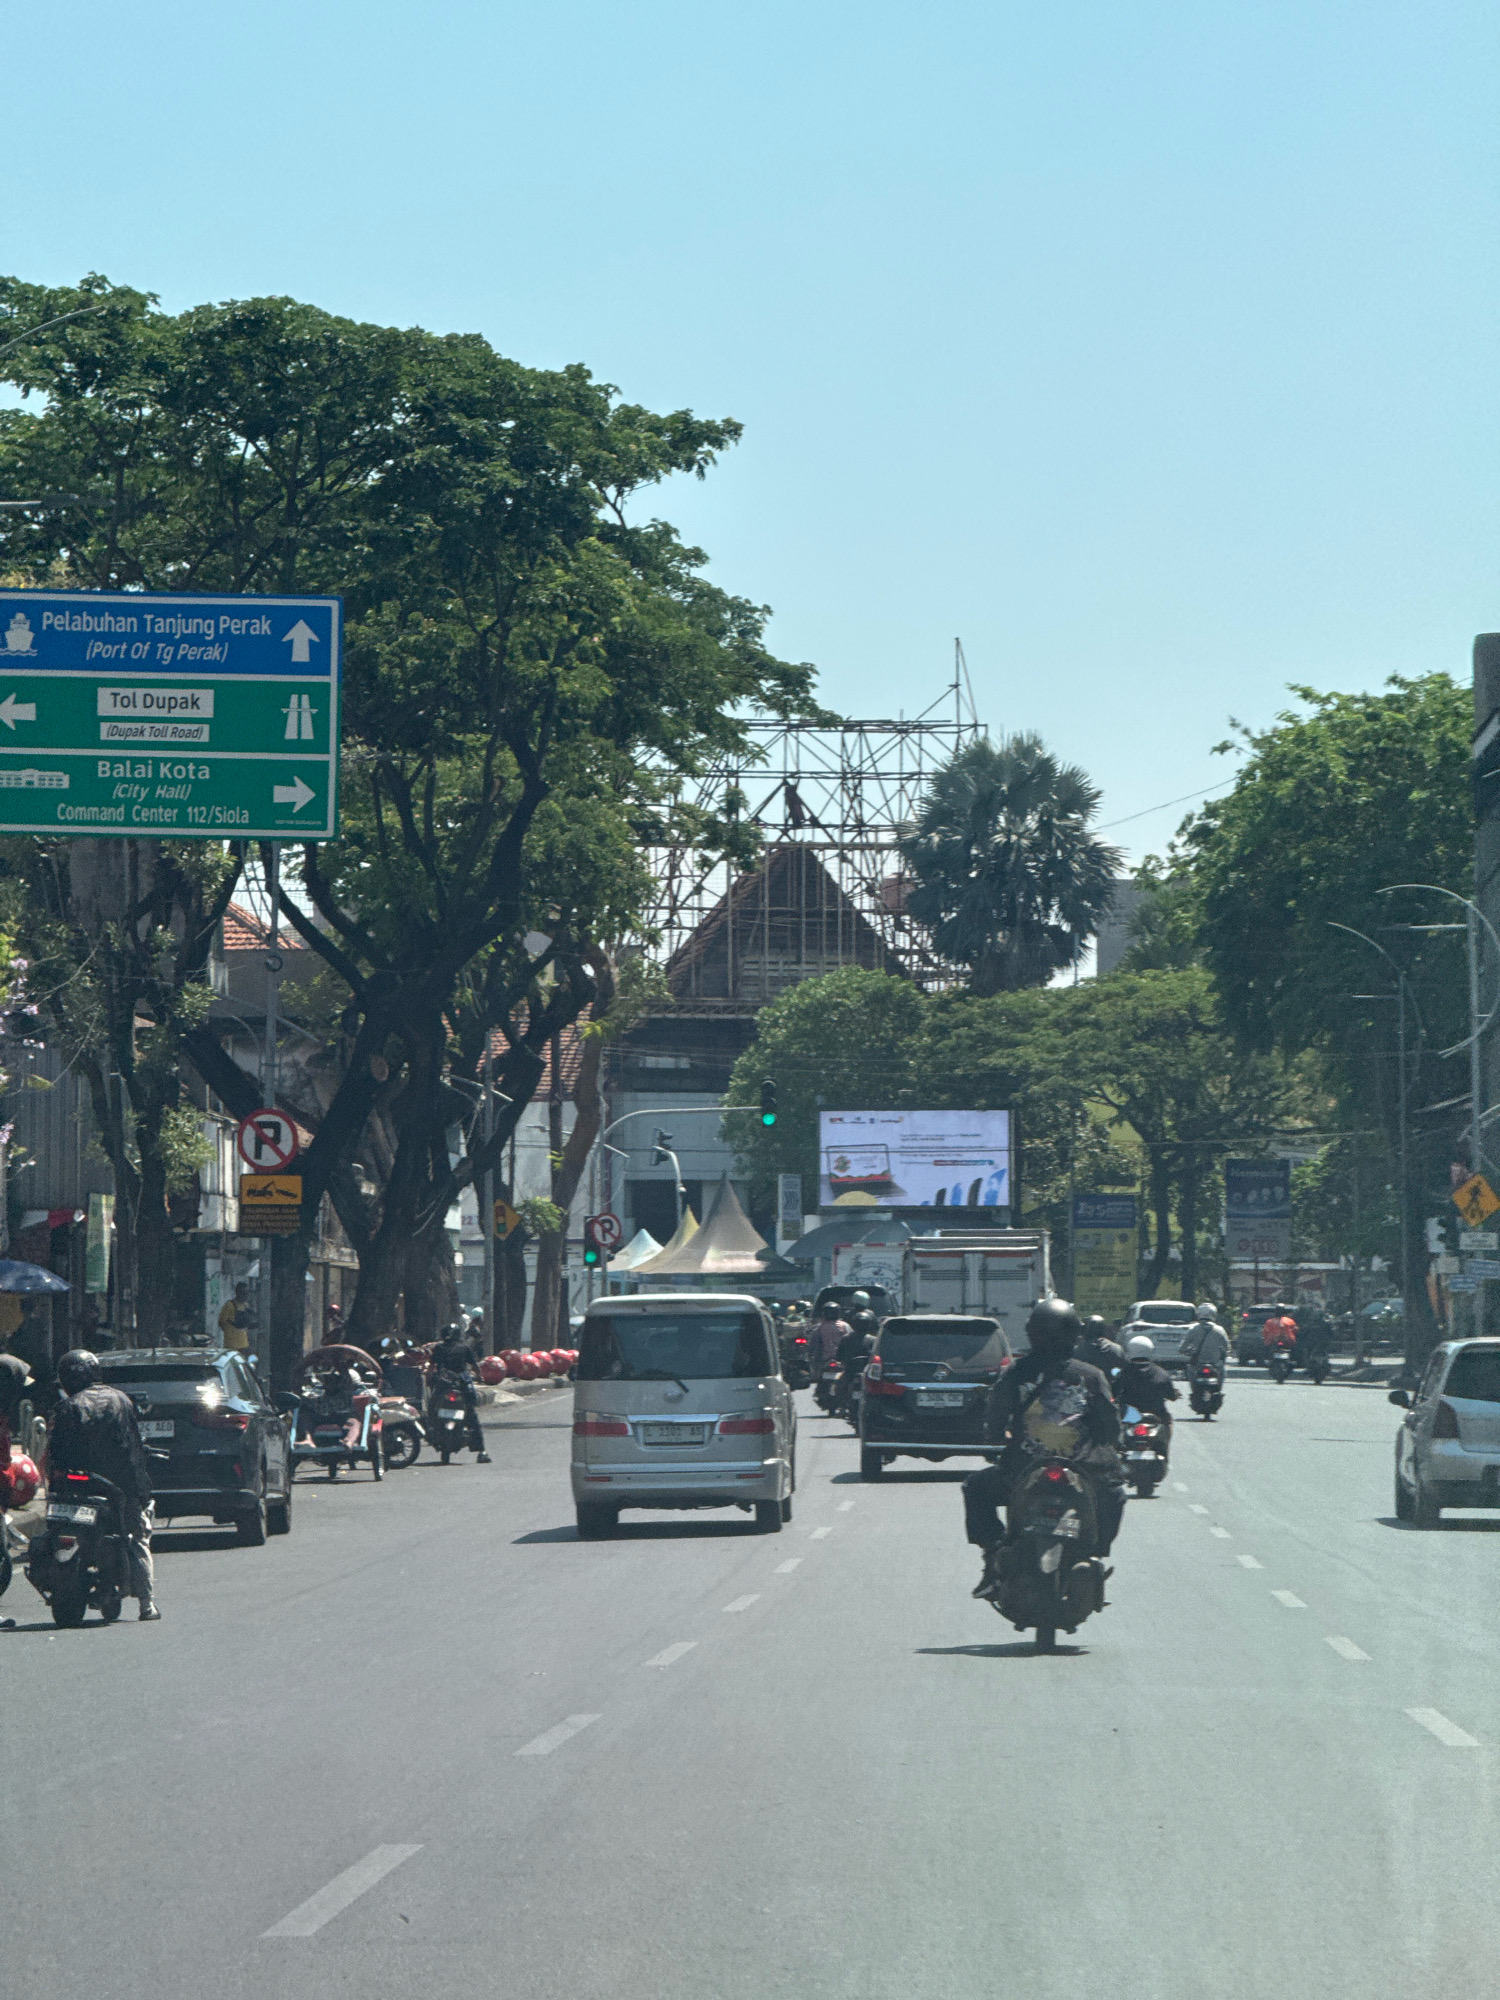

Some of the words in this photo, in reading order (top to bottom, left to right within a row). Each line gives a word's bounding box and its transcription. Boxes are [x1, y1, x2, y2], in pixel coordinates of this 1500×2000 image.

[42, 610, 138, 633] Pelabuhan
[143, 613, 215, 640] Tanjung
[219, 614, 272, 635] Perak
[86, 639, 128, 661] (Port
[130, 641, 152, 660] Of
[156, 643, 175, 665] Tg
[176, 641, 229, 663] Perak)
[110, 691, 137, 709] Tol
[142, 692, 201, 714] Dupak
[106, 724, 147, 741] (Dupak
[148, 725, 169, 738] Toll
[170, 726, 204, 740] Road)
[97, 760, 154, 779] Balai
[159, 762, 211, 780] Kota
[112, 783, 150, 802] (City
[154, 783, 193, 801] Hall)
[56, 802, 126, 822] Command
[131, 804, 178, 823] Center
[186, 804, 250, 825] 112/Siola
